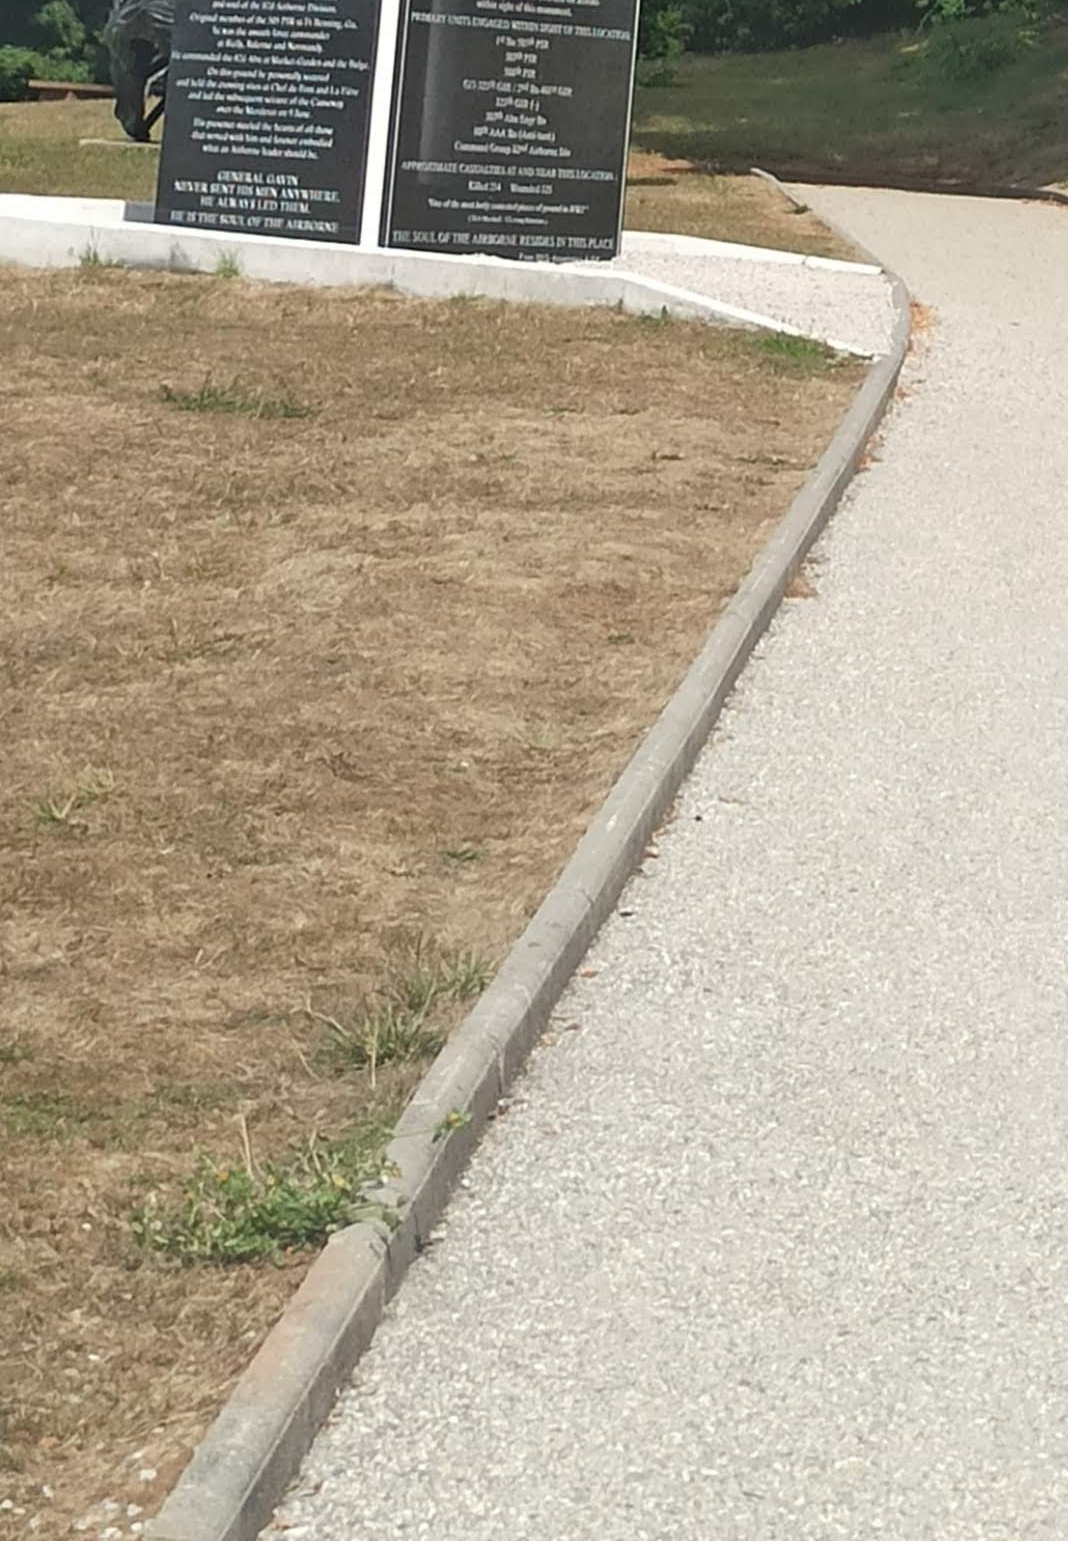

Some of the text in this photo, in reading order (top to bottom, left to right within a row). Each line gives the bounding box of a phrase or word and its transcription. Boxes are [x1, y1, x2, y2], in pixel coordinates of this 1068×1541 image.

[218, 170, 299, 186] GENERAL GAVIN
[174, 180, 209, 193] NEVER
[210, 183, 236, 195] SENT
[218, 196, 256, 209] ALWAYS
[220, 214, 246, 226] SOUL
[287, 219, 339, 233] AIRBORNE
[412, 232, 438, 243] SOUL
[472, 234, 517, 246] AIRBORNE
[520, 236, 555, 248] RESIDES
[568, 238, 588, 249] THIS
[588, 239, 614, 250] PLACE
